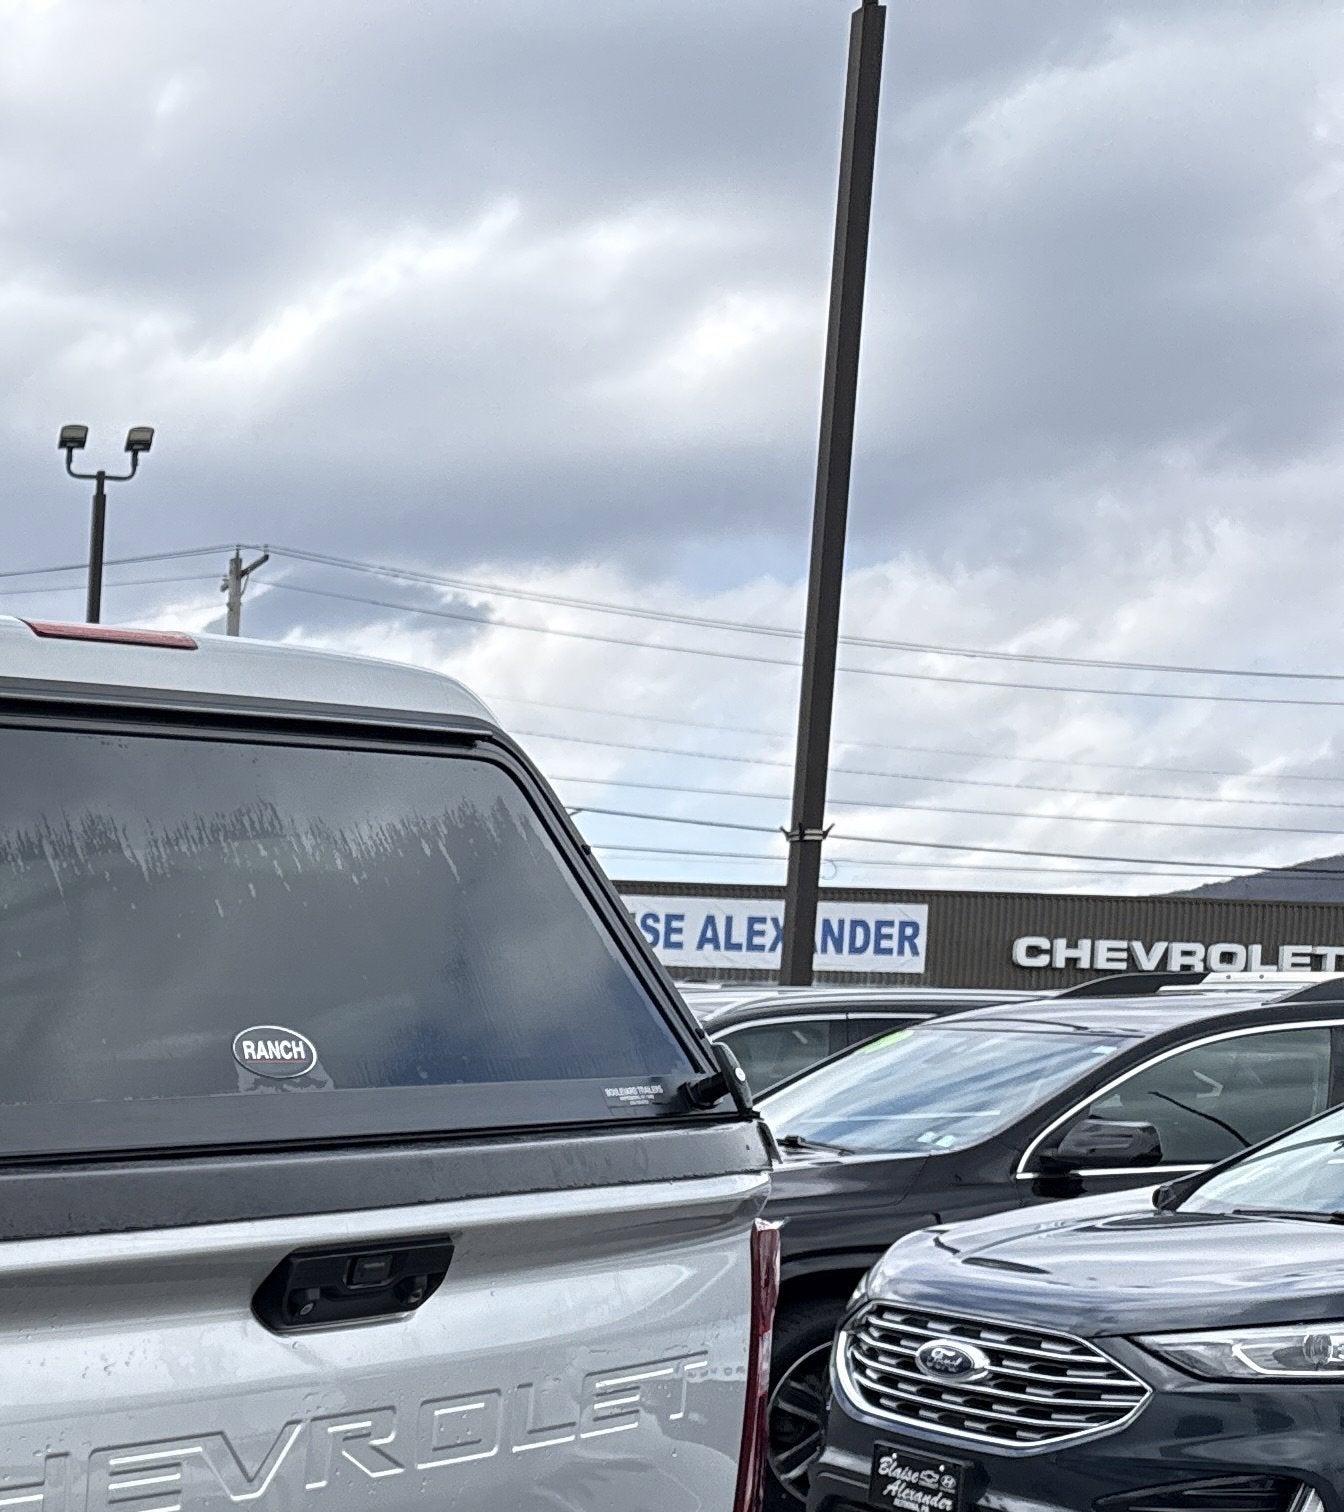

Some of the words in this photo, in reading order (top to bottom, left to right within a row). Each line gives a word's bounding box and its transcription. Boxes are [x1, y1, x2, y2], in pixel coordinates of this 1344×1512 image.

[696, 913, 920, 956] ALEXNDER
[1012, 936, 1344, 972] CHEVROLET
[242, 1040, 306, 1060] RANCH
[878, 1456, 920, 1484] Blaise
[882, 1479, 953, 1512] Alexander
